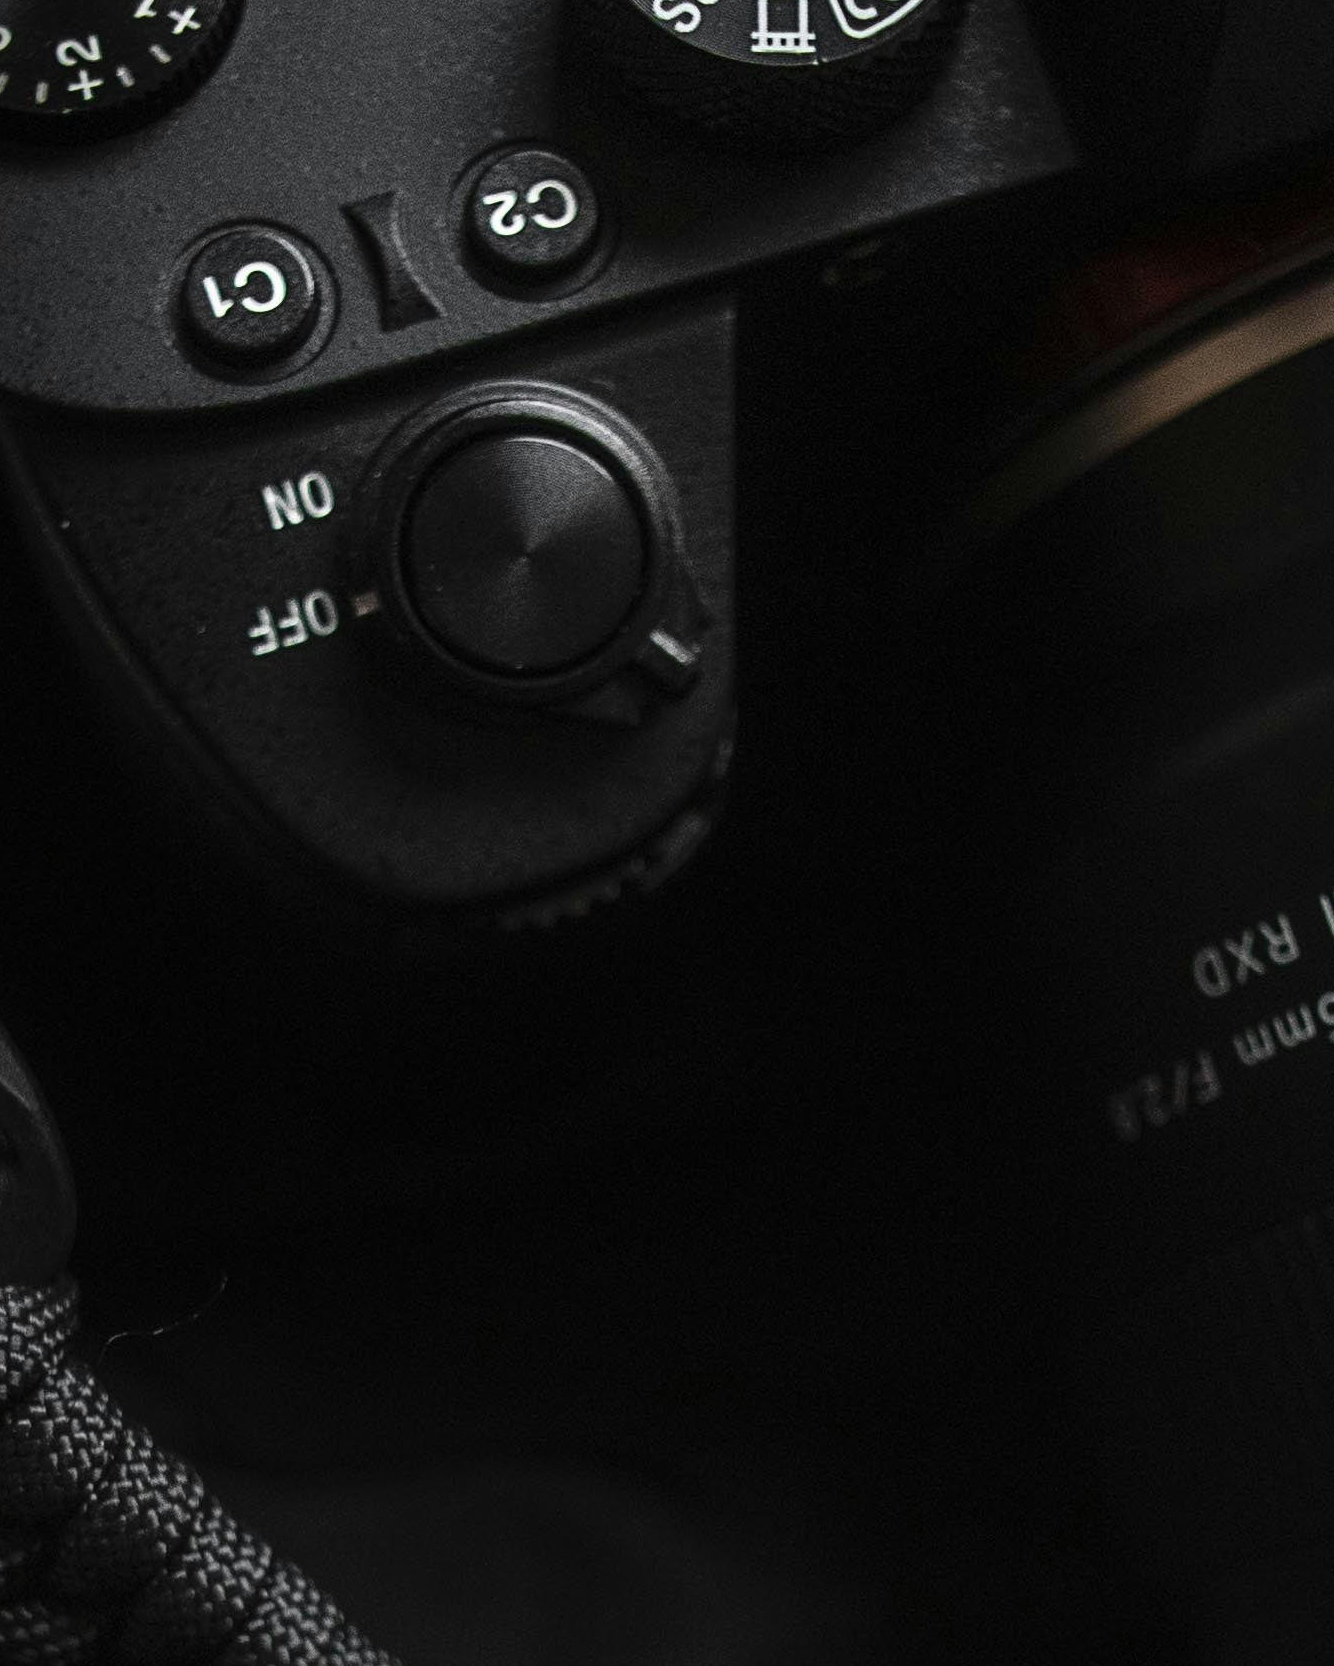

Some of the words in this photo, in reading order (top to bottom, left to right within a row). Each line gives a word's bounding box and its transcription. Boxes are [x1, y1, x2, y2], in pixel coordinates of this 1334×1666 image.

[482, 180, 578, 236] C2
[202, 261, 287, 317] C1
[261, 471, 335, 530] ON
[247, 589, 339, 657] OFF
[1193, 913, 1300, 998] RXD
